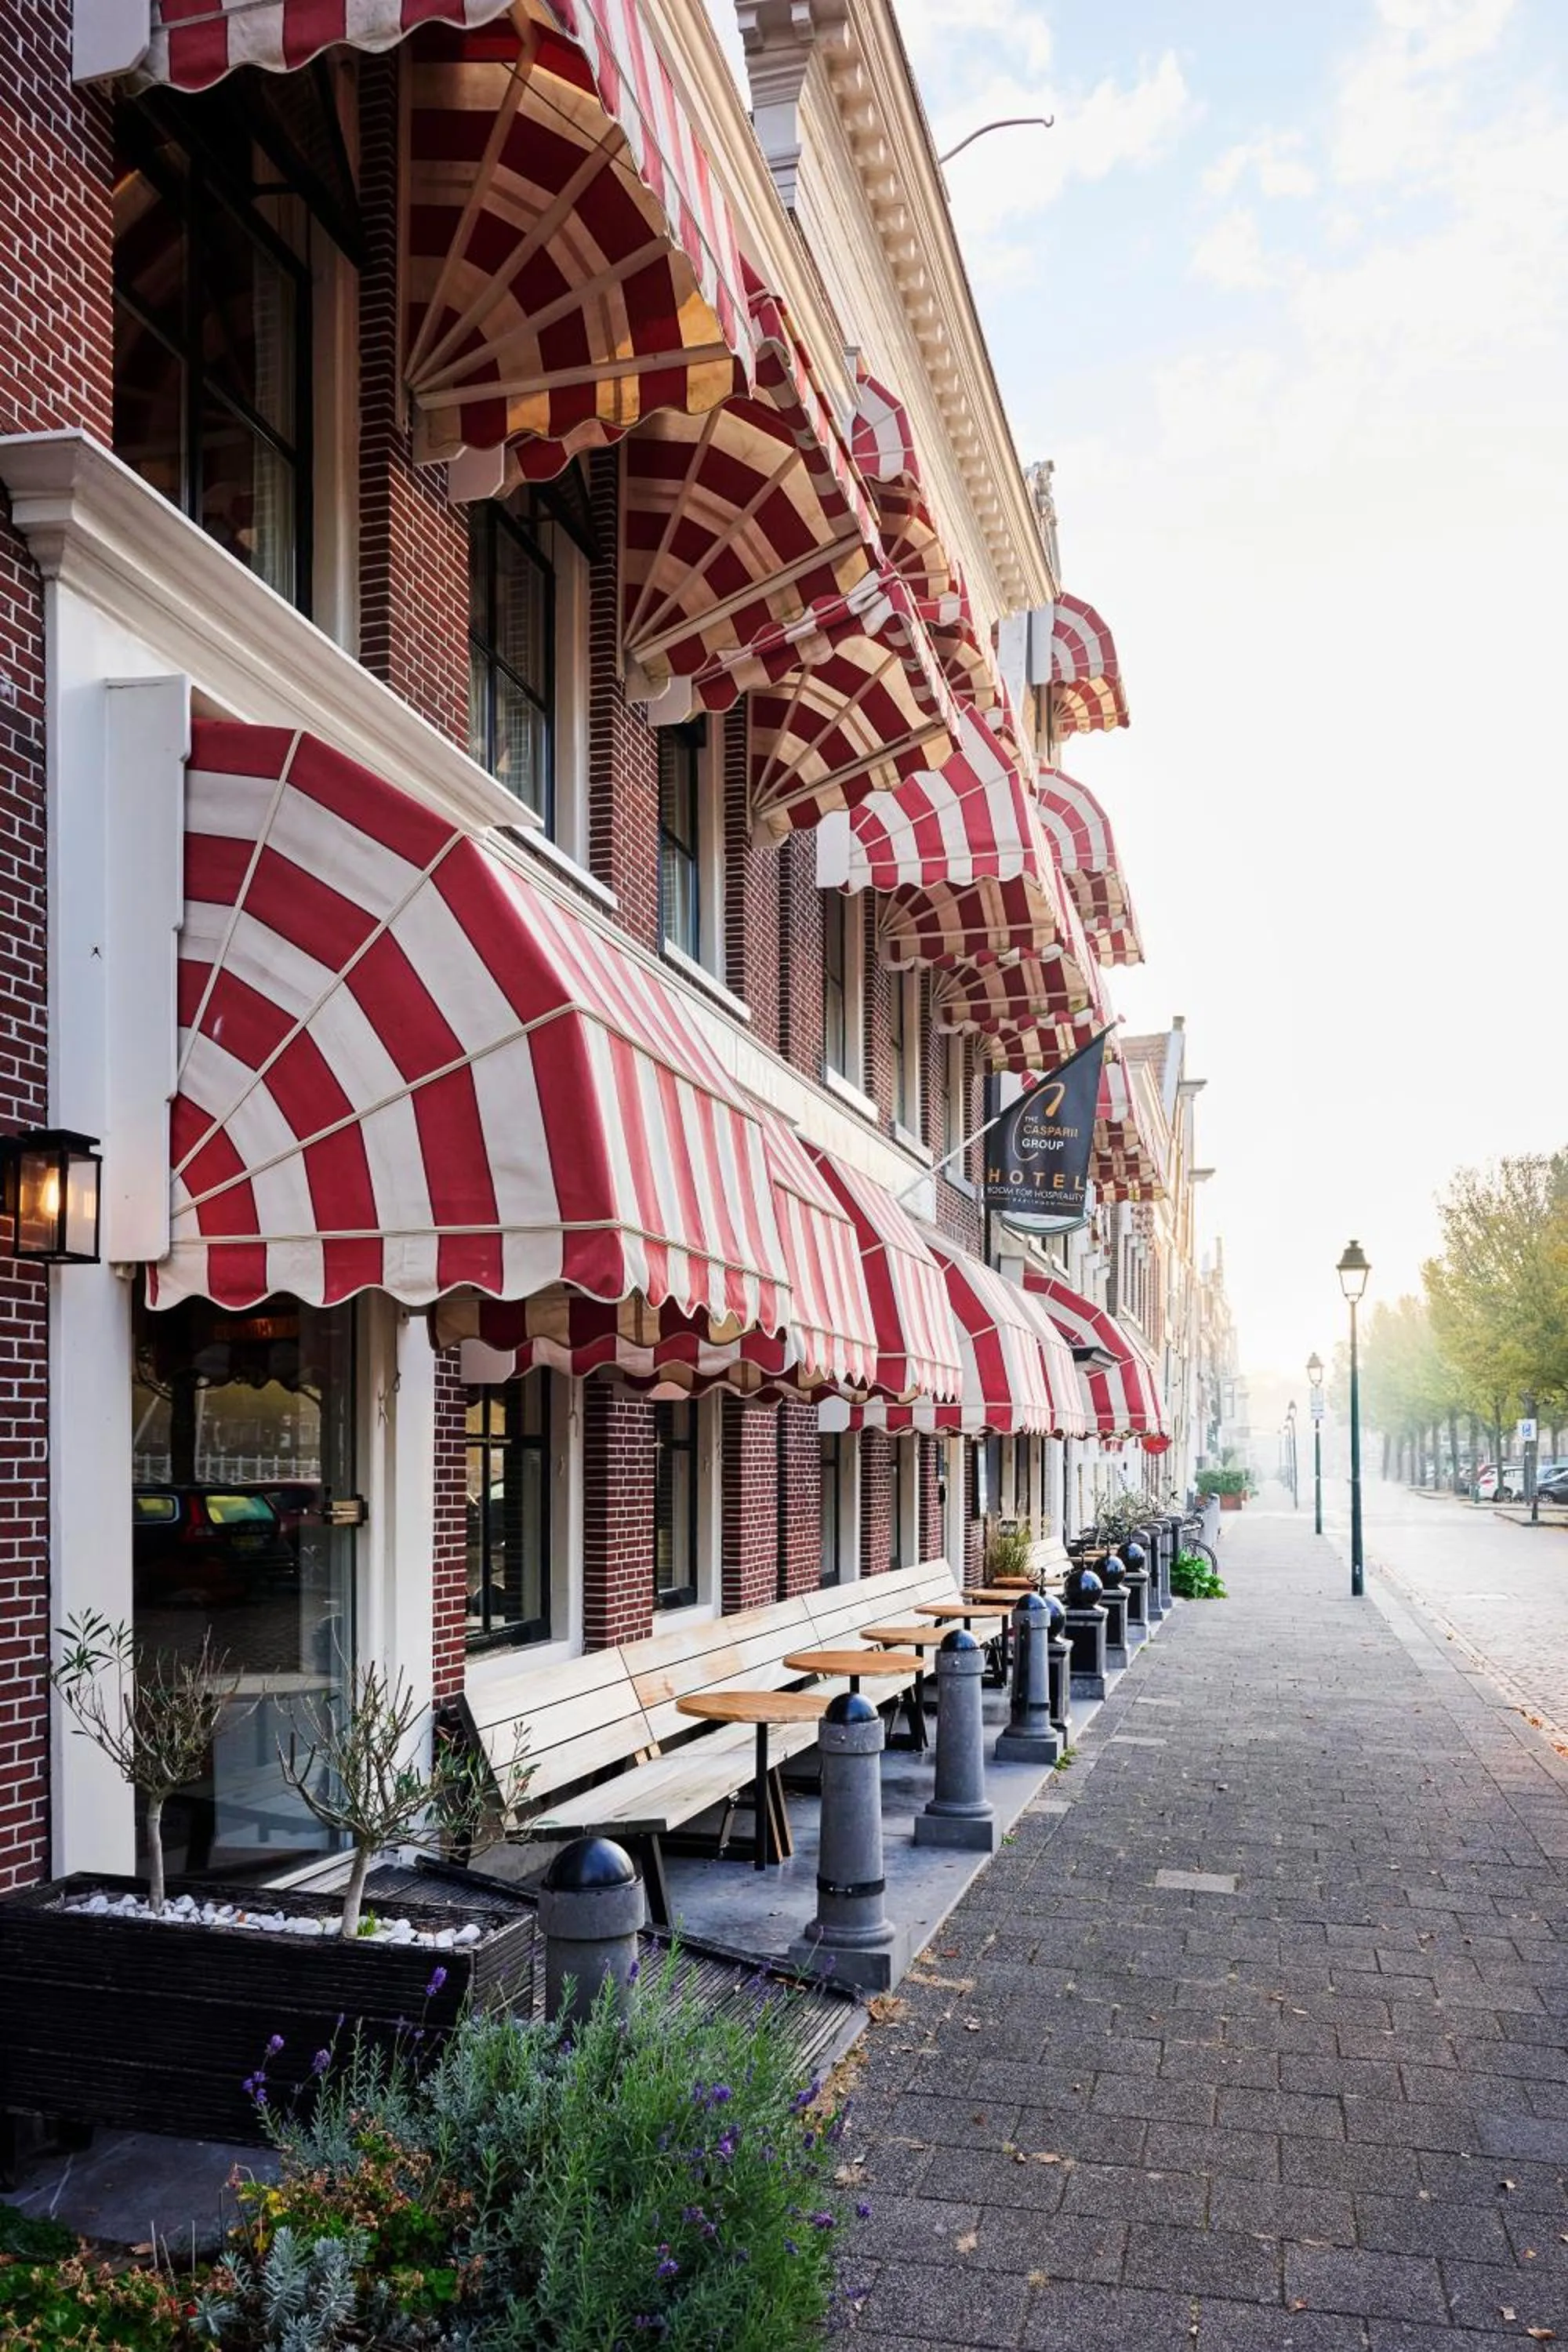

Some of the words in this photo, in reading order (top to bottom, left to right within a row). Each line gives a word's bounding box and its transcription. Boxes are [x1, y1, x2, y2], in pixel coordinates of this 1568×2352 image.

[1022, 1138, 1064, 1150] GROUP
[989, 1168, 1084, 1190] HOTEL
[1015, 1188, 1033, 1197] FOR
[1034, 1190, 1084, 1202] HOSPITALITY
